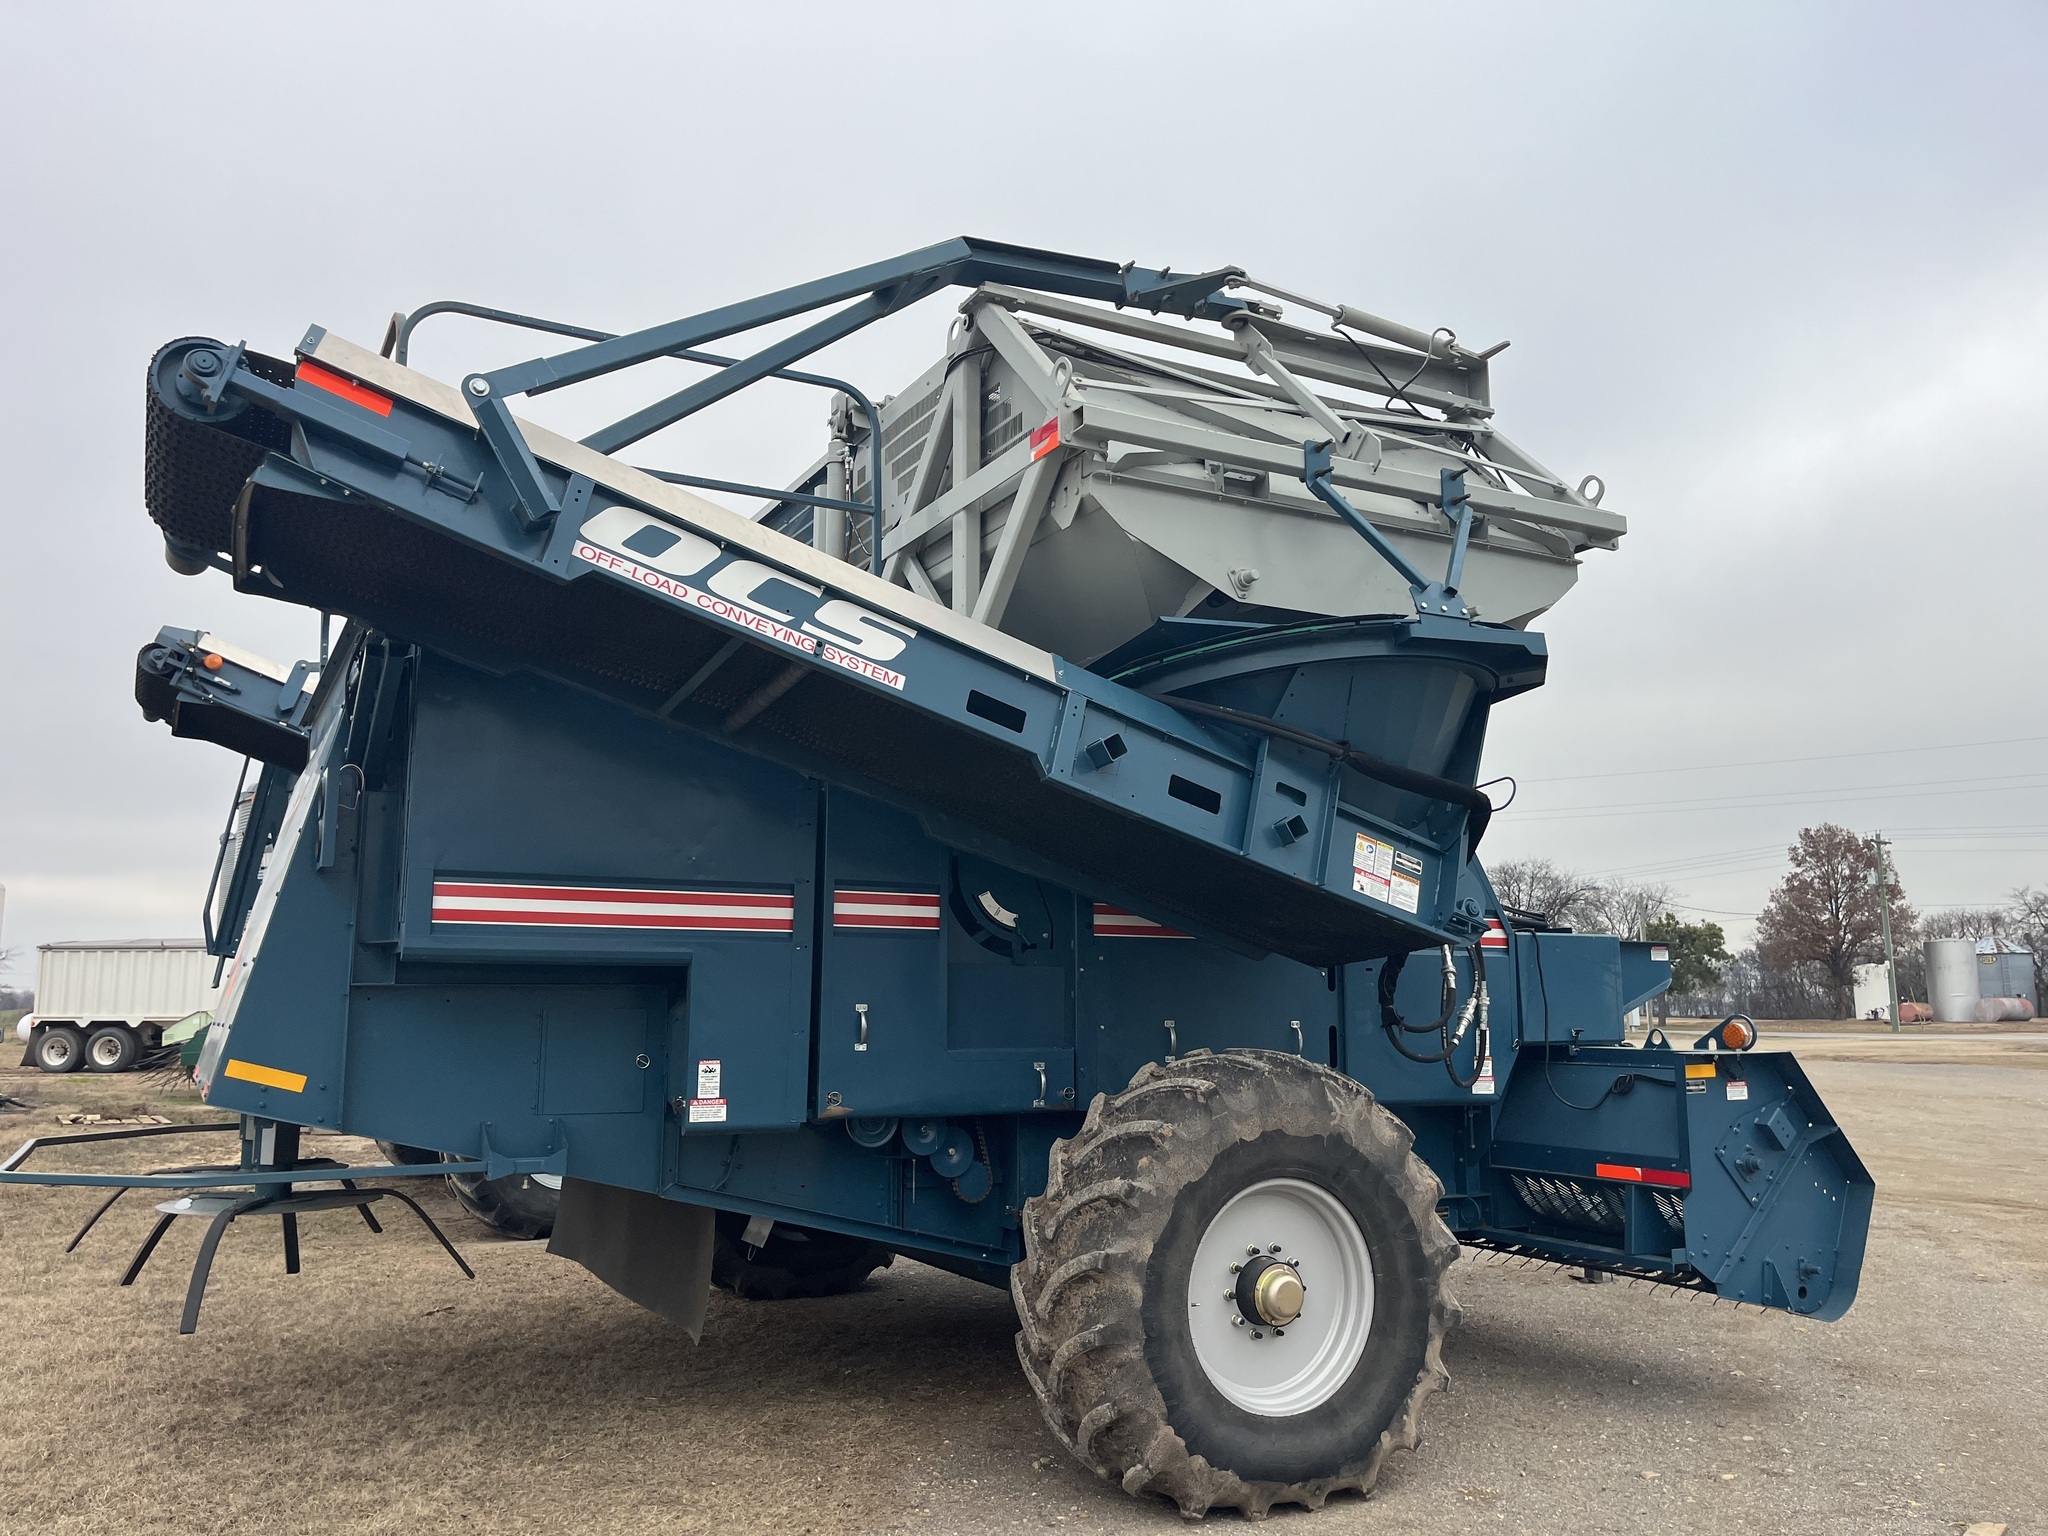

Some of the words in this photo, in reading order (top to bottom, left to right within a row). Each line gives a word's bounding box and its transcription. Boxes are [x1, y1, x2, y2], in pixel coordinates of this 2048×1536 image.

[579, 506, 918, 662] OCS
[579, 545, 689, 599] OFF-LOAD
[696, 594, 816, 652] CONVEYING
[822, 646, 899, 687] SYSTEM
